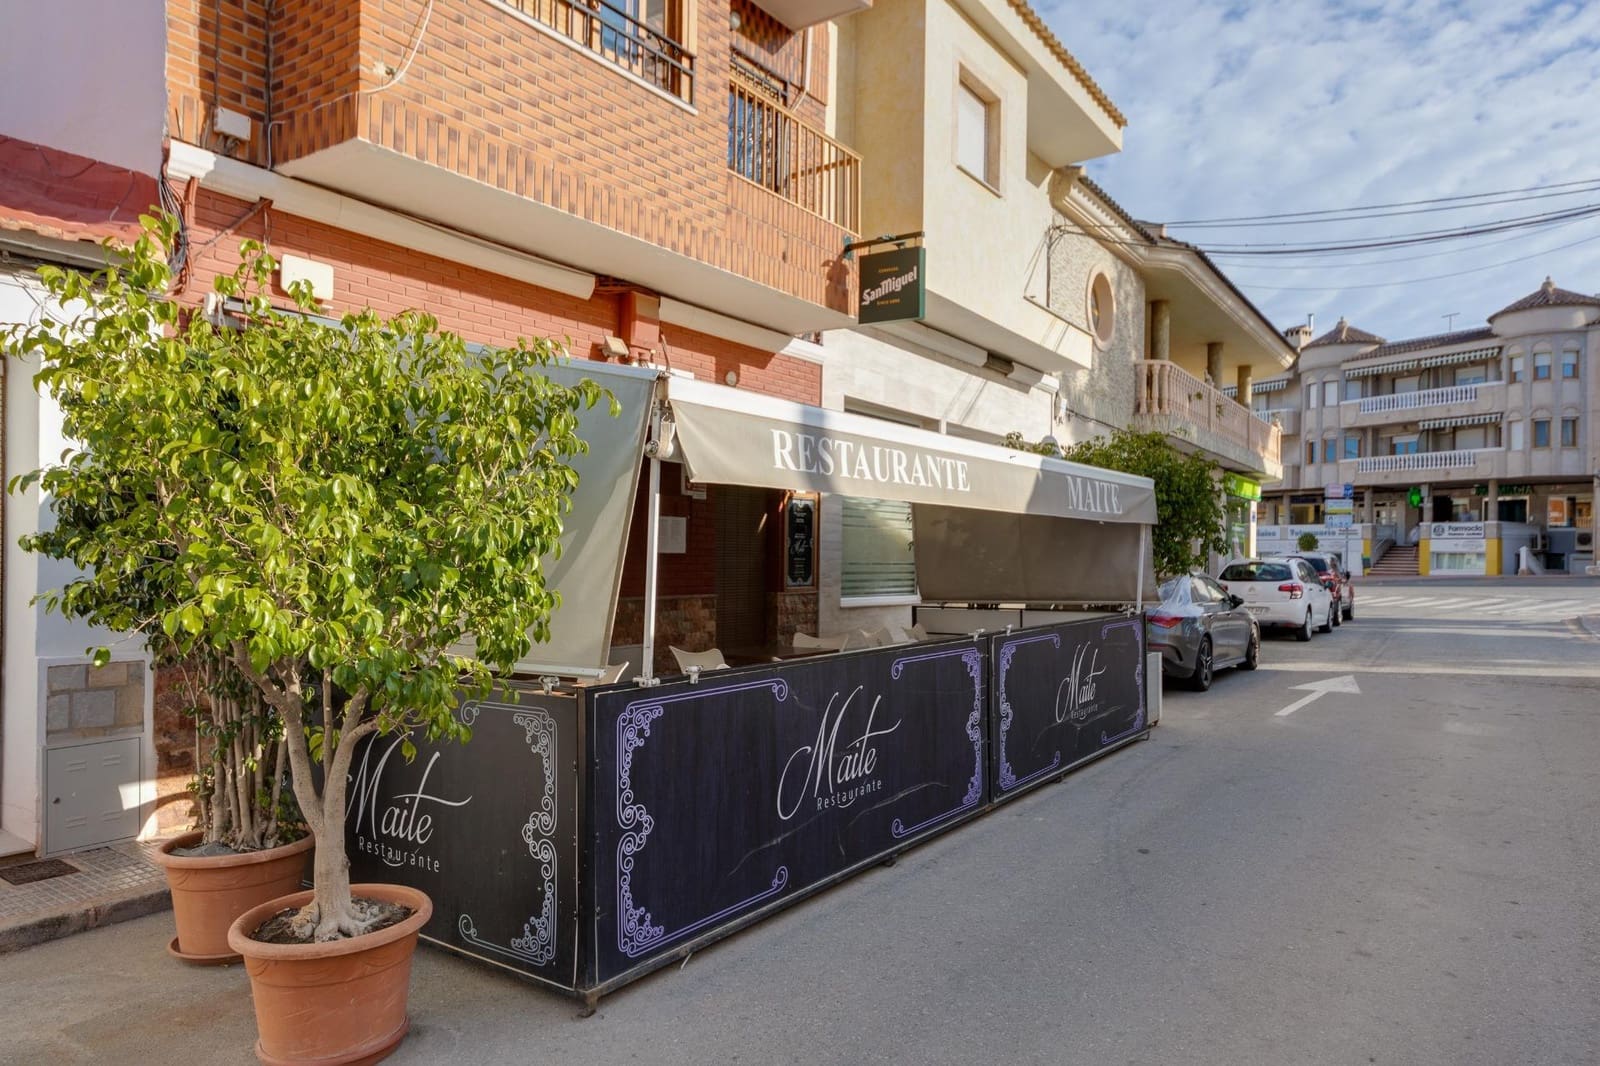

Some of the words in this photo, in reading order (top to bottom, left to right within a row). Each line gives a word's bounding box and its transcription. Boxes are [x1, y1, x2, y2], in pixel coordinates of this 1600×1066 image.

[770, 428, 971, 492] RESTAURANTE
[1066, 475, 1123, 514] MAITE
[1056, 641, 1107, 723] Maite
[345, 730, 473, 844] Maite
[777, 685, 902, 820] Maite
